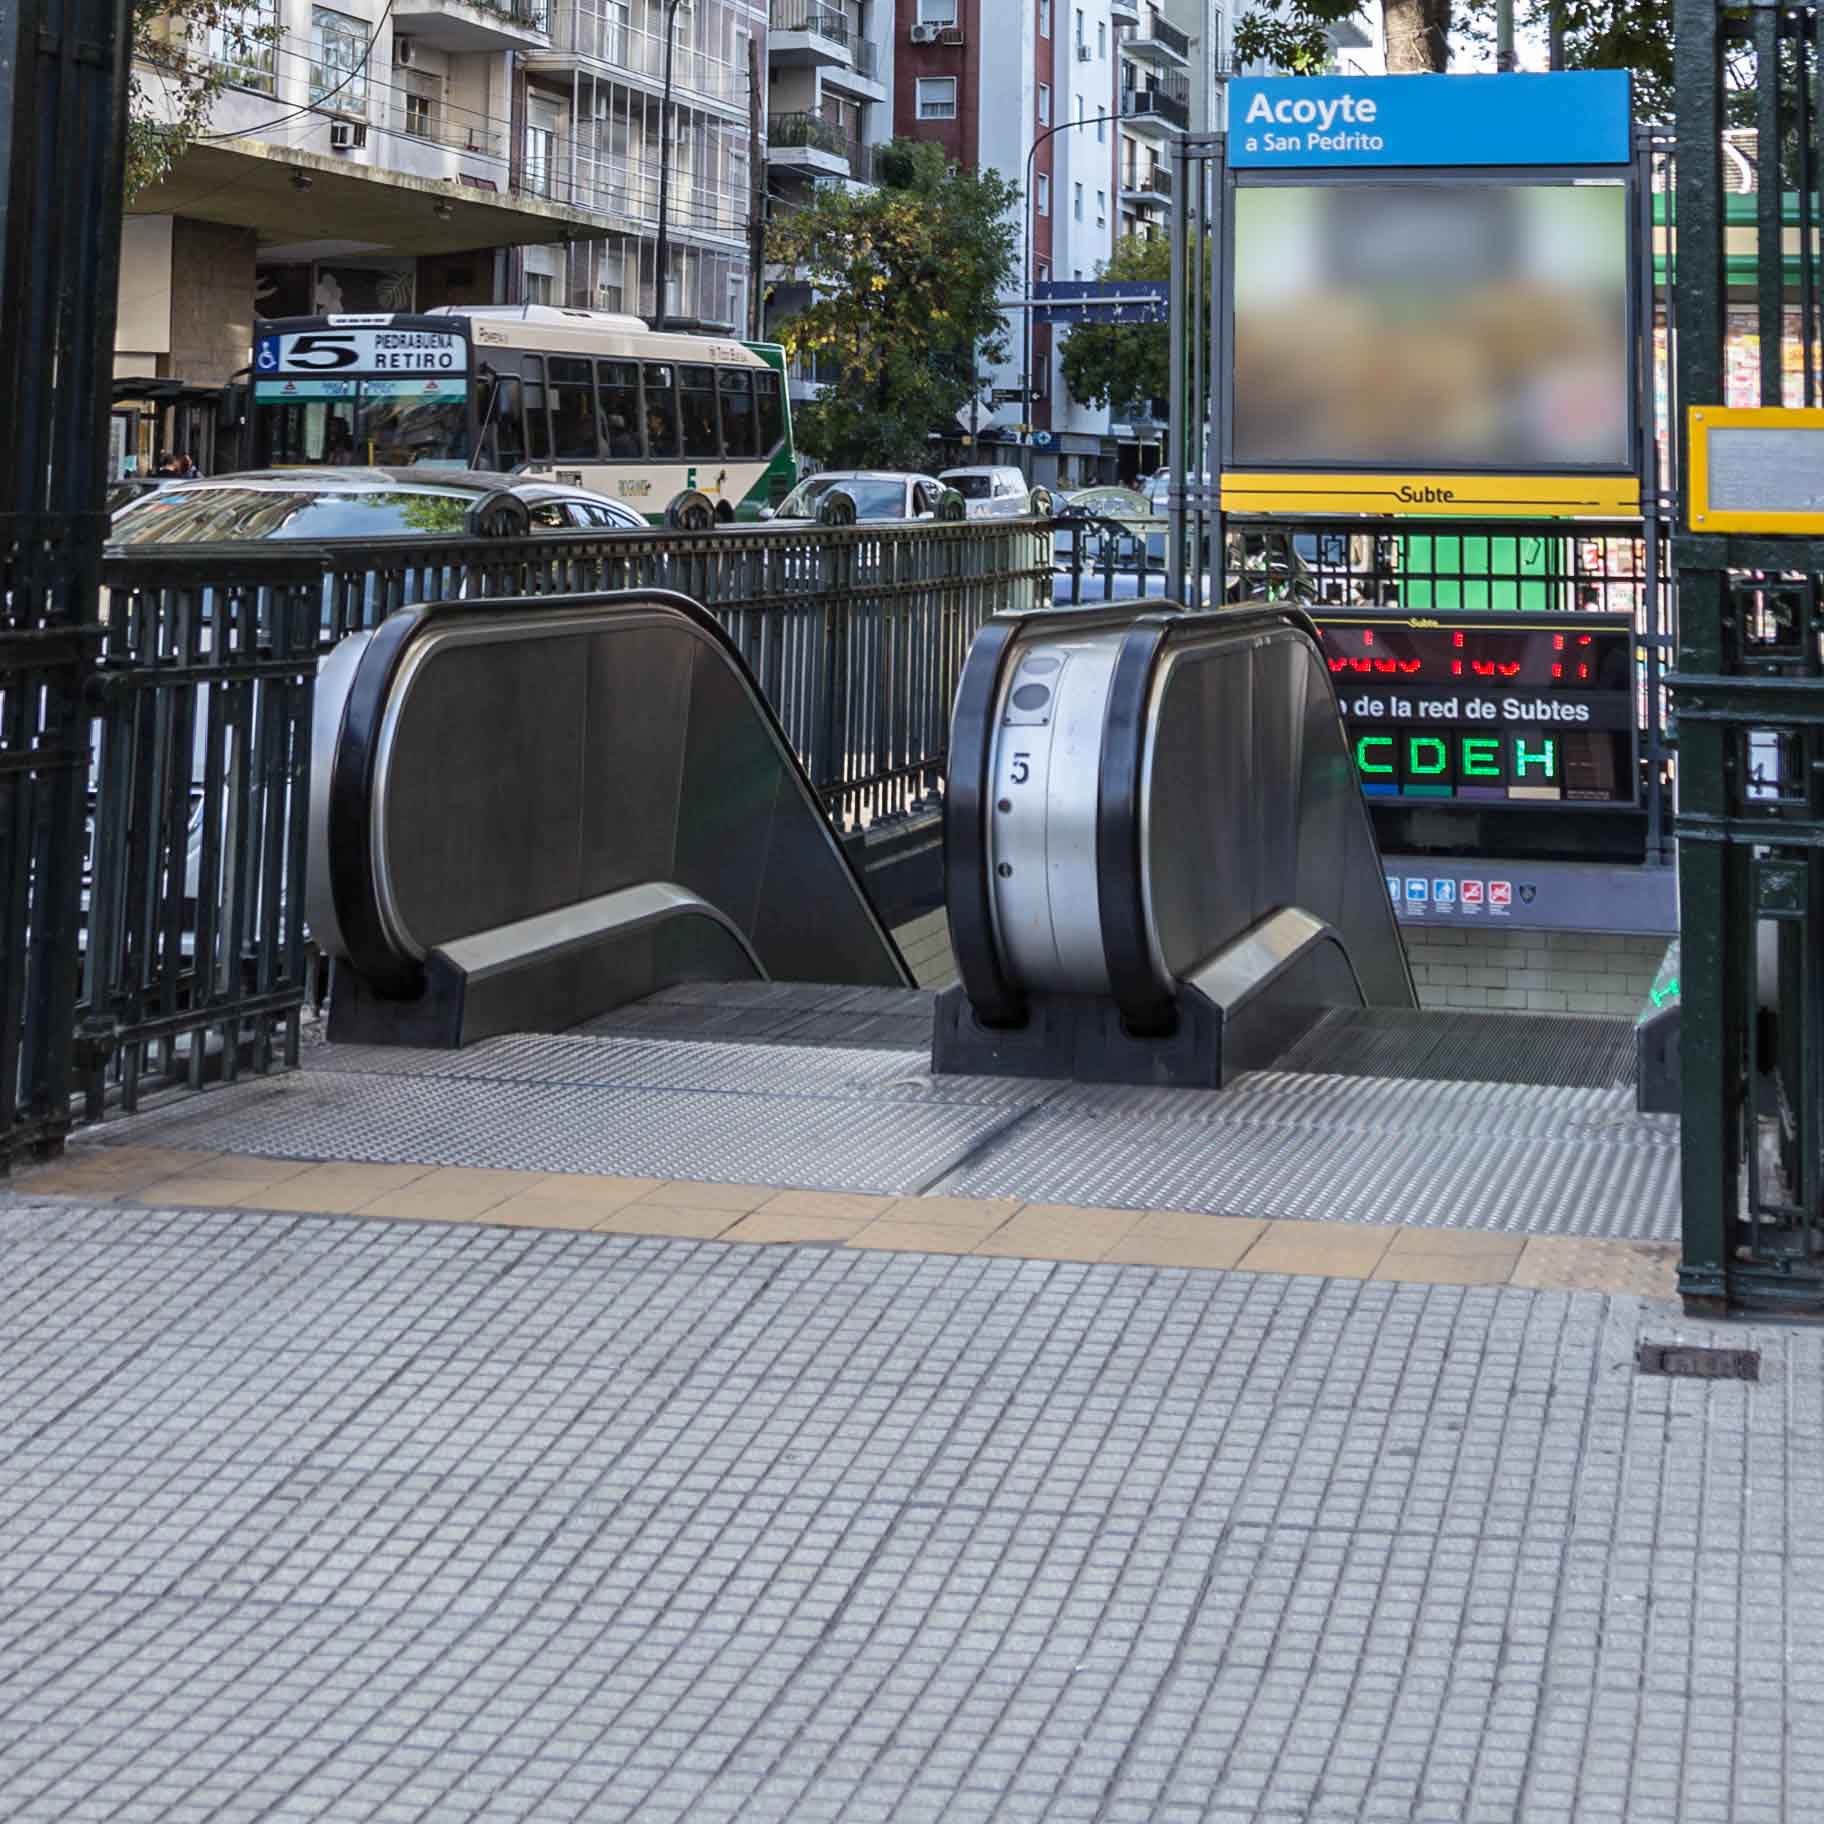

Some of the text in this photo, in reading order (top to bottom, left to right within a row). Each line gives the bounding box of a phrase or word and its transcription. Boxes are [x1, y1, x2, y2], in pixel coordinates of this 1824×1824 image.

[1245, 92, 1377, 131] Acoyte
[1245, 132, 1384, 152] a San Pedrito
[287, 335, 360, 370] 5
[375, 352, 453, 369] RETIRO
[1398, 485, 1454, 504] Subte
[1354, 696, 1384, 717] de
[1391, 696, 1412, 717] la
[1418, 696, 1459, 718] red
[1464, 698, 1497, 719] de
[1503, 700, 1590, 721] Subtes
[1010, 751, 1031, 785] 5
[1357, 736, 1554, 777] C D E H
